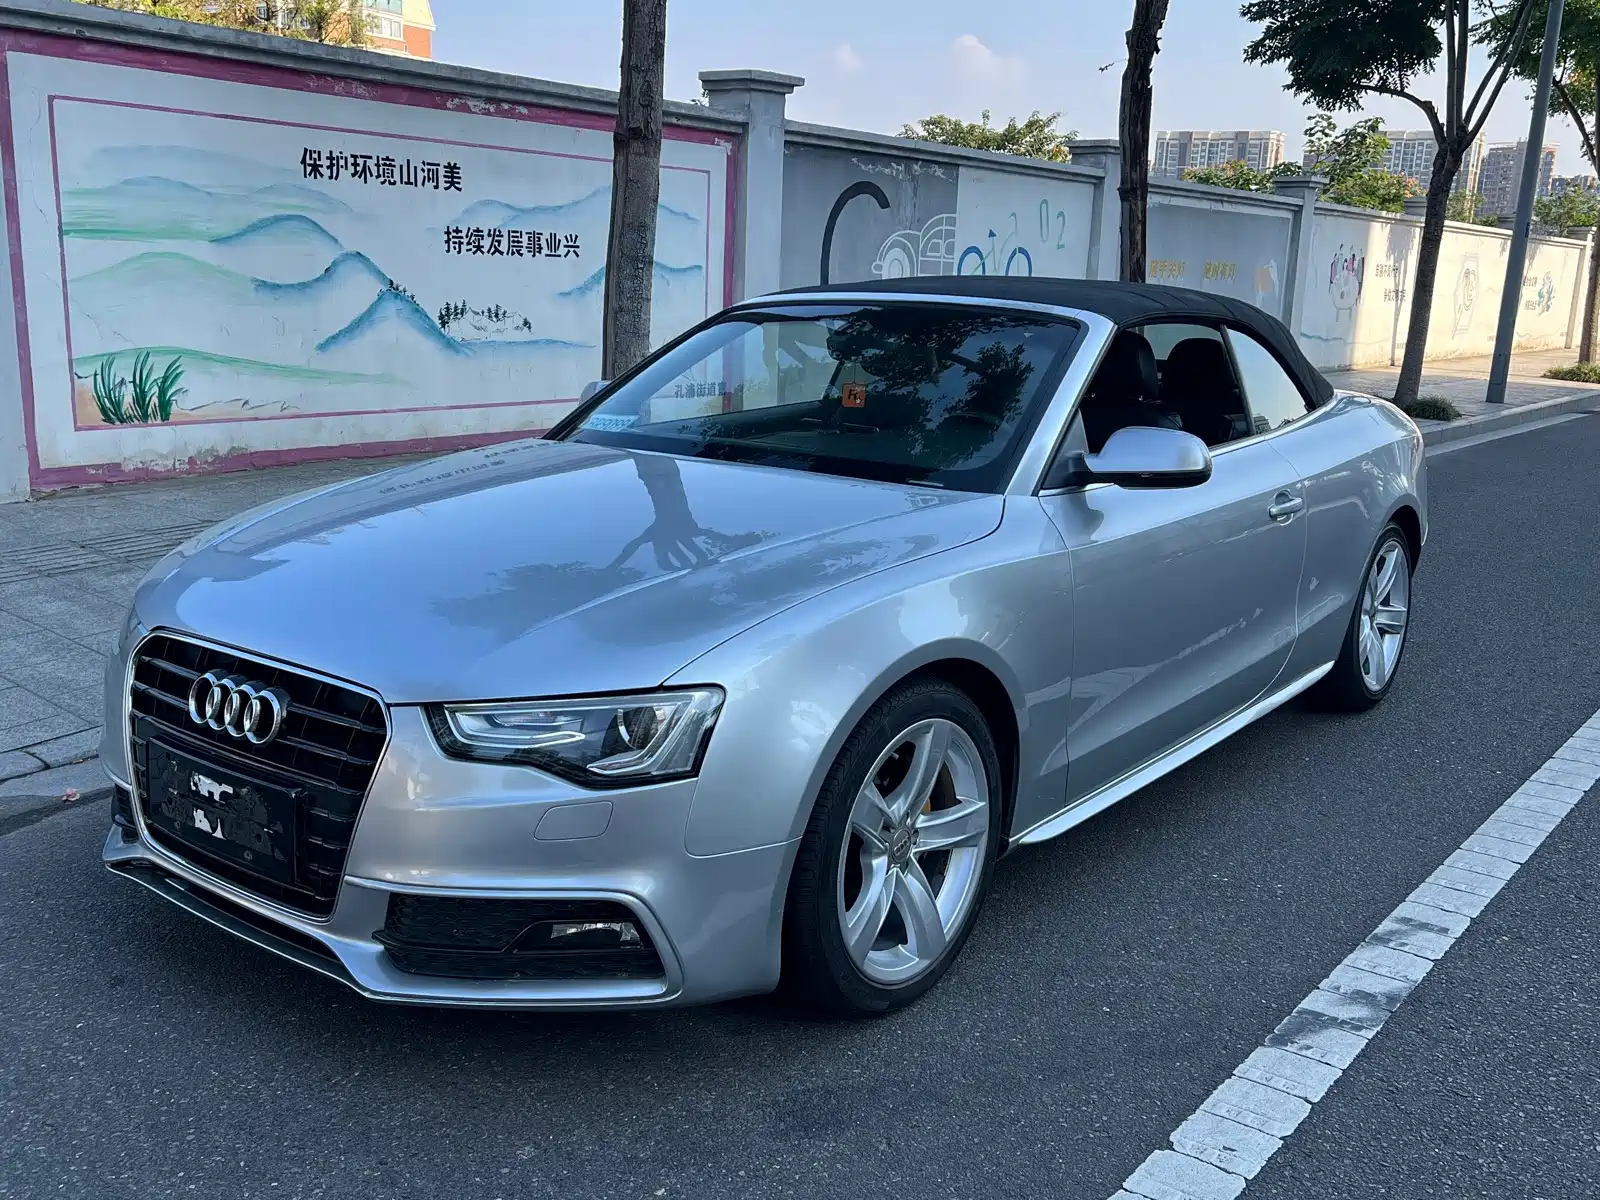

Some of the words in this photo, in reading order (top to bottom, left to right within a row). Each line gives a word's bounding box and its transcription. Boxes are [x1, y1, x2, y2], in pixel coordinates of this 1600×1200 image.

[300, 147, 463, 192] 保护环境山河美
[443, 225, 580, 258] 持续发展事业兴
